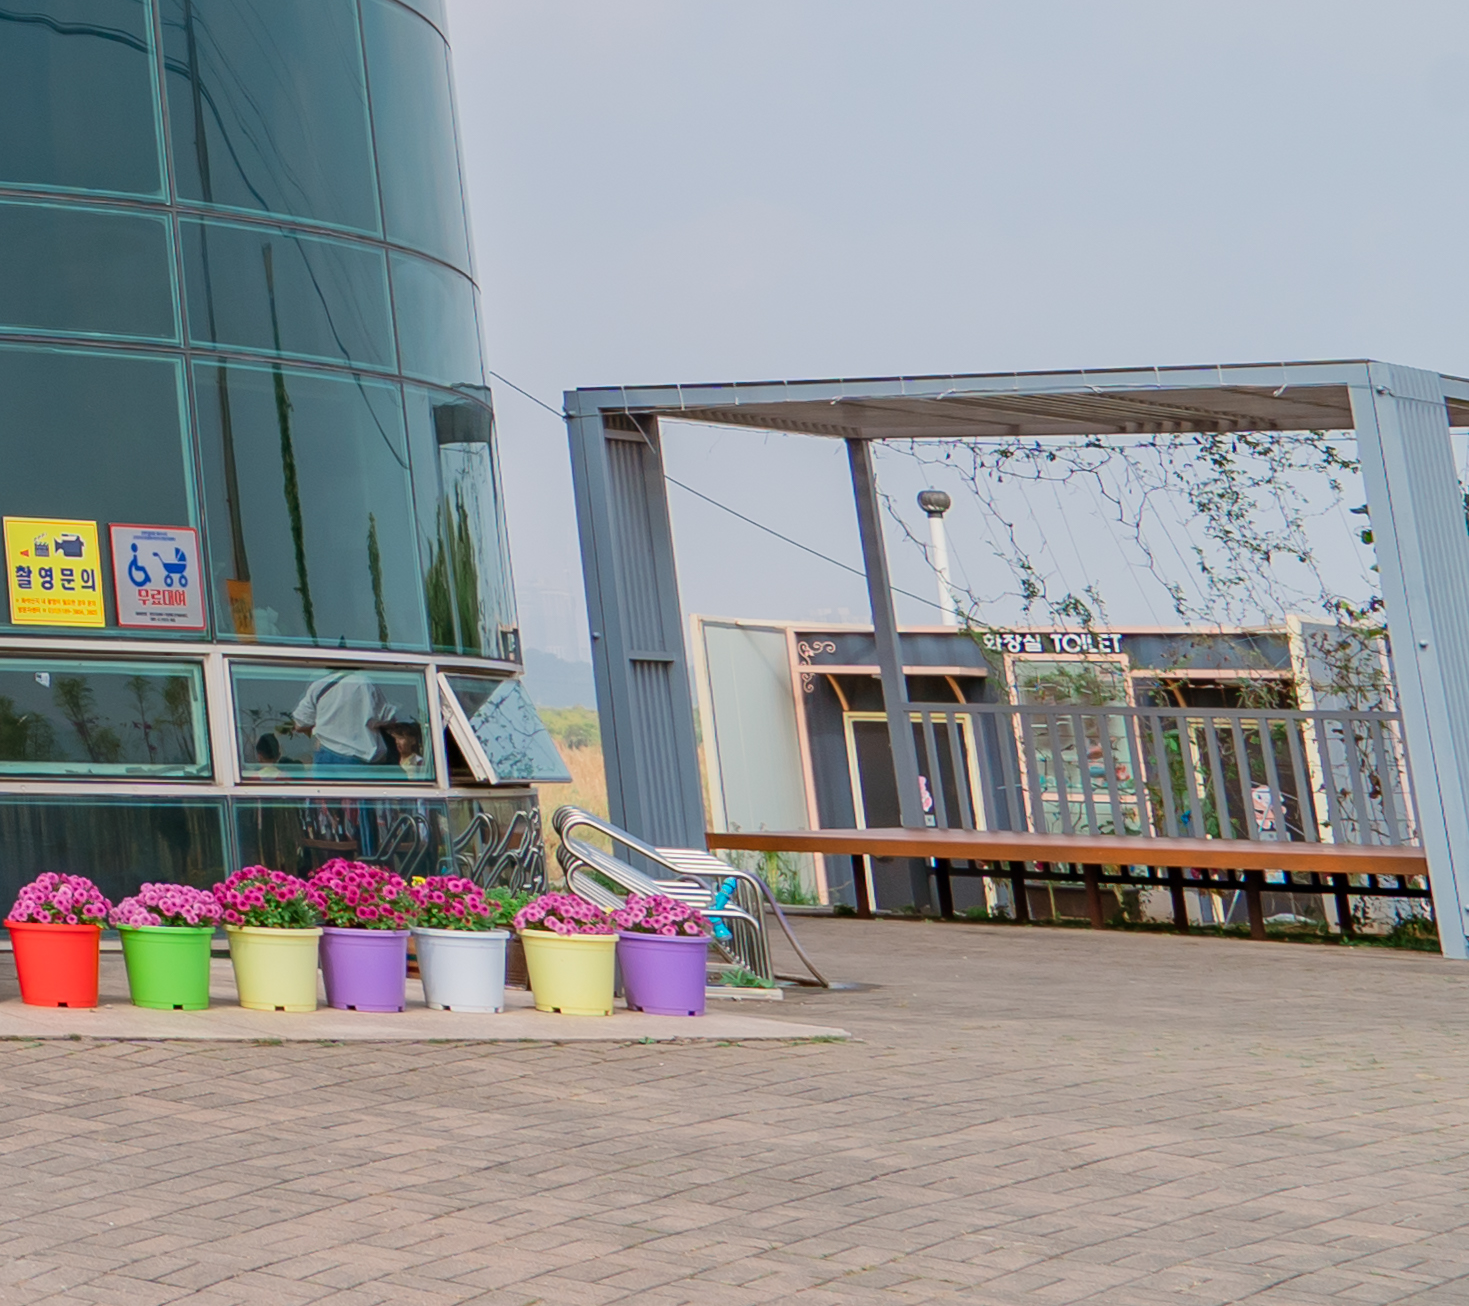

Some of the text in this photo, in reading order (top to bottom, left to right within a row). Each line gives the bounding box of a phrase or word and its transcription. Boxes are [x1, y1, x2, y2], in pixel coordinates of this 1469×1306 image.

[14, 565, 96, 592] 촬영문의
[137, 588, 187, 607] 무료대여
[983, 633, 1123, 653] 화장실 TOILET
